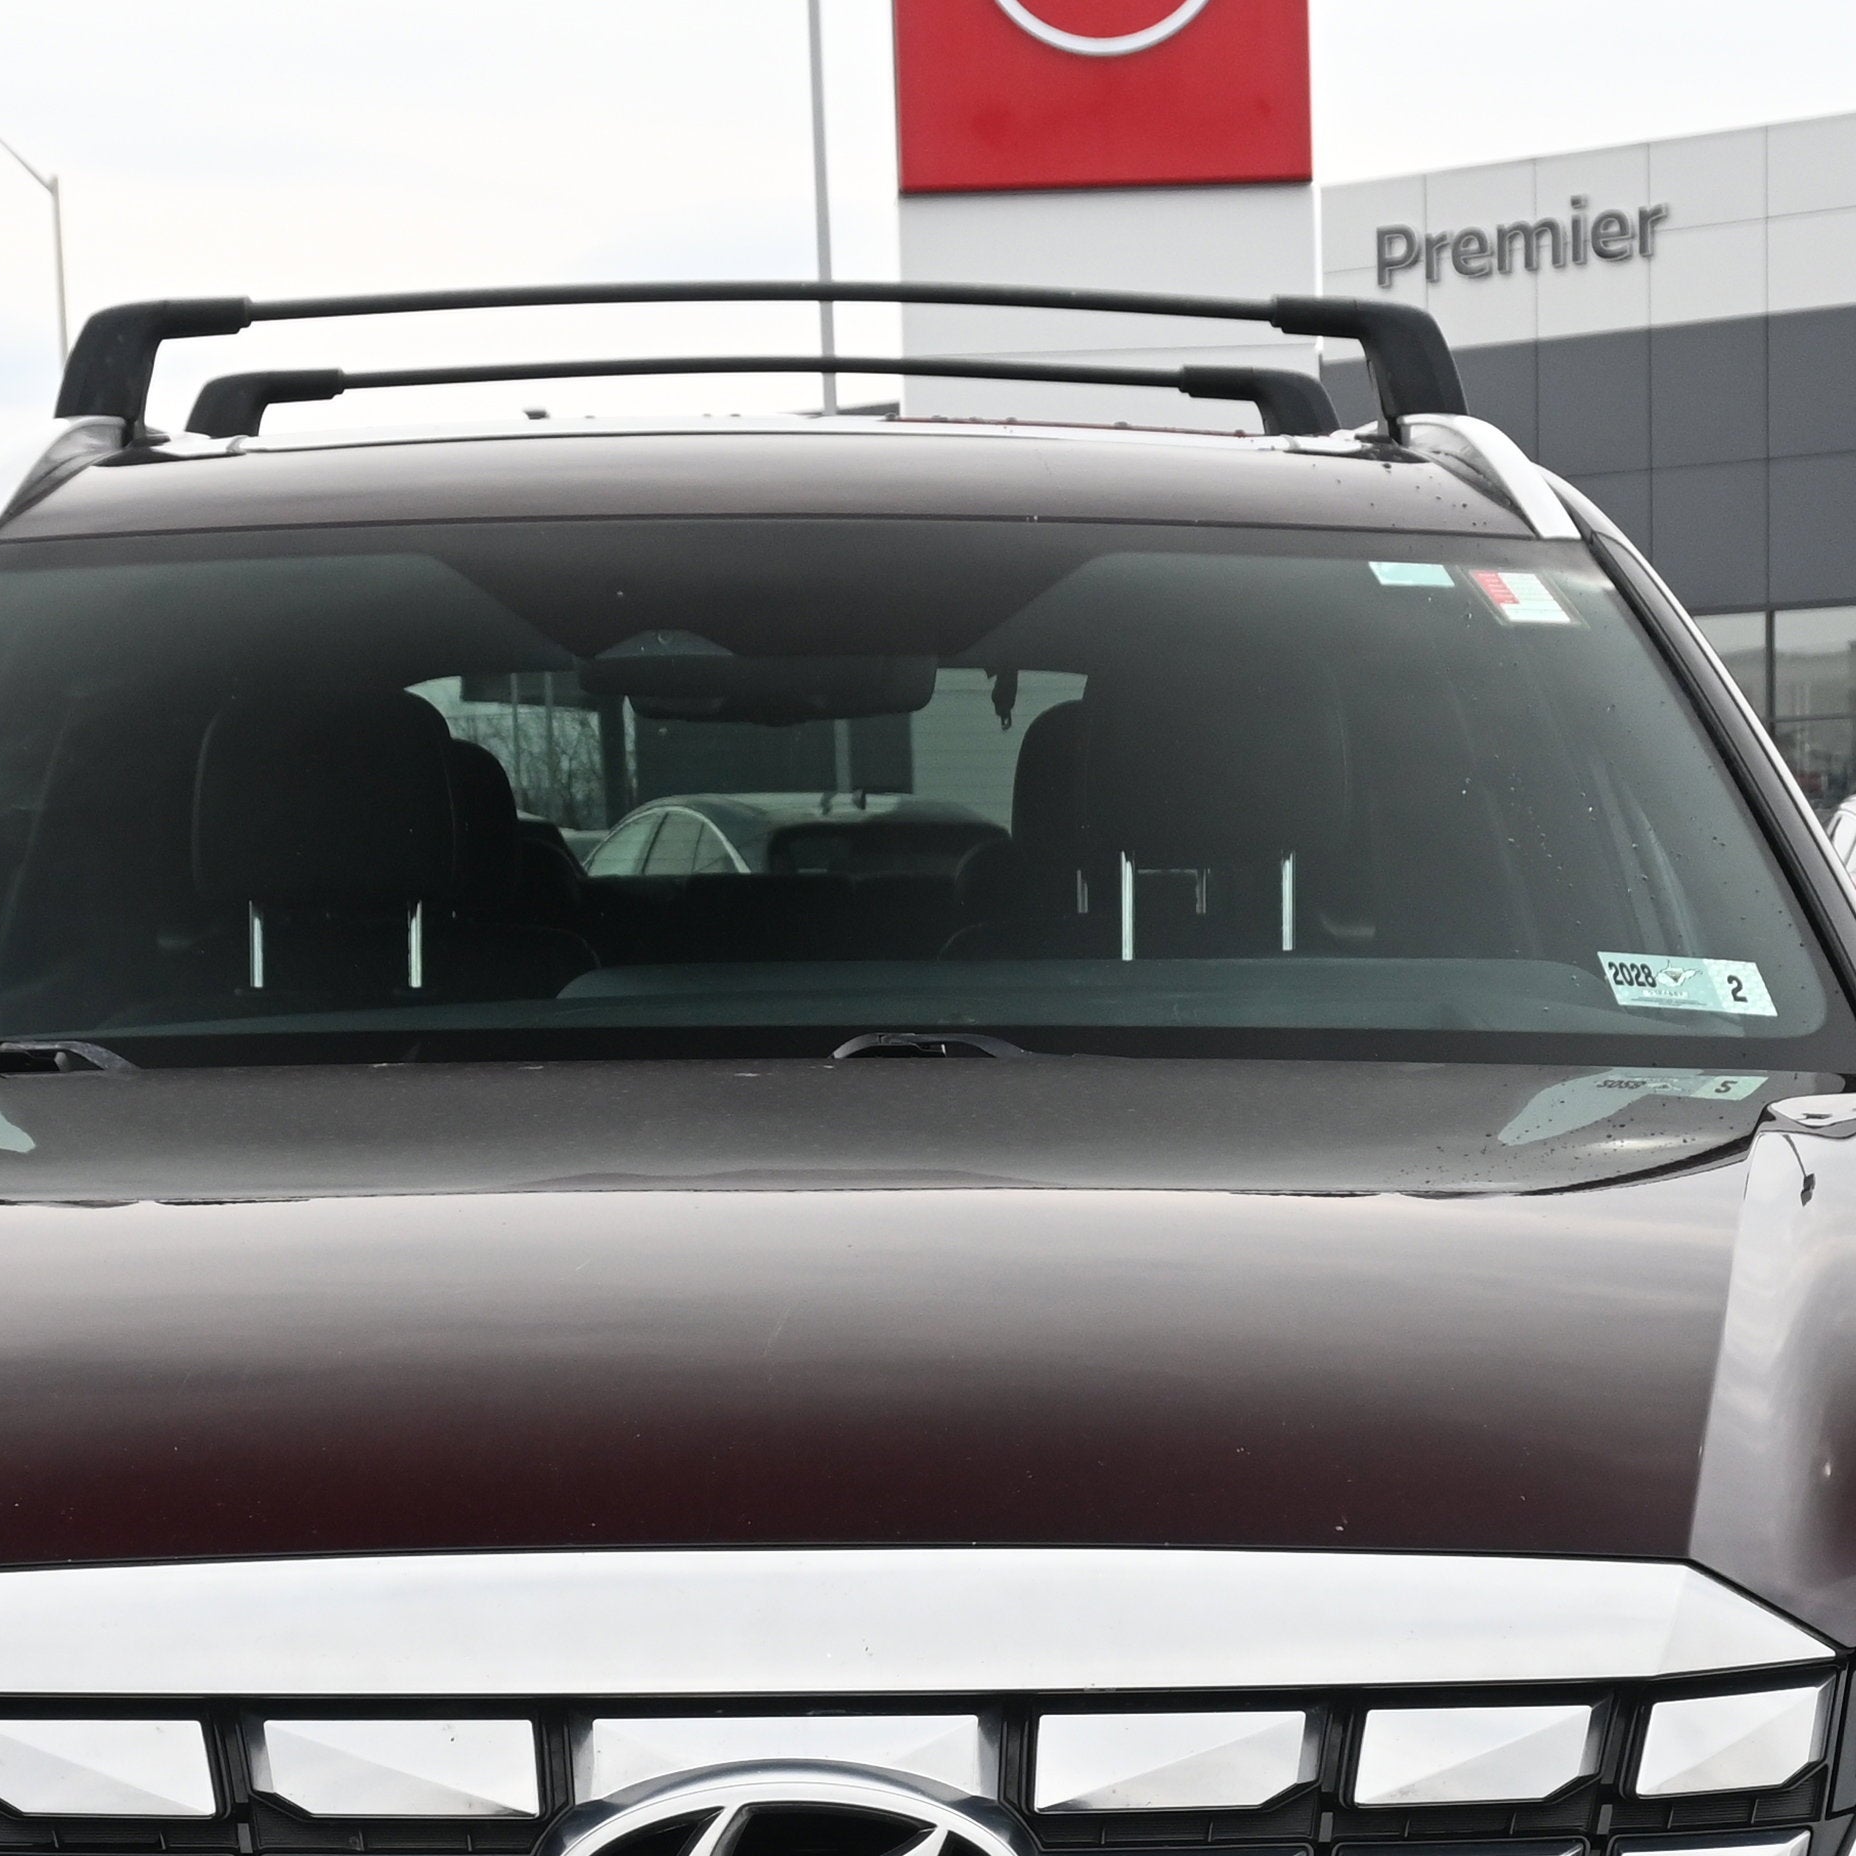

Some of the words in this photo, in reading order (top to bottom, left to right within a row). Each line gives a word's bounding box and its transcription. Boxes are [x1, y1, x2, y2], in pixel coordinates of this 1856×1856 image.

[1376, 194, 1669, 288] Premier
[1608, 961, 1657, 988] 2028
[1727, 975, 1748, 1003] 2
